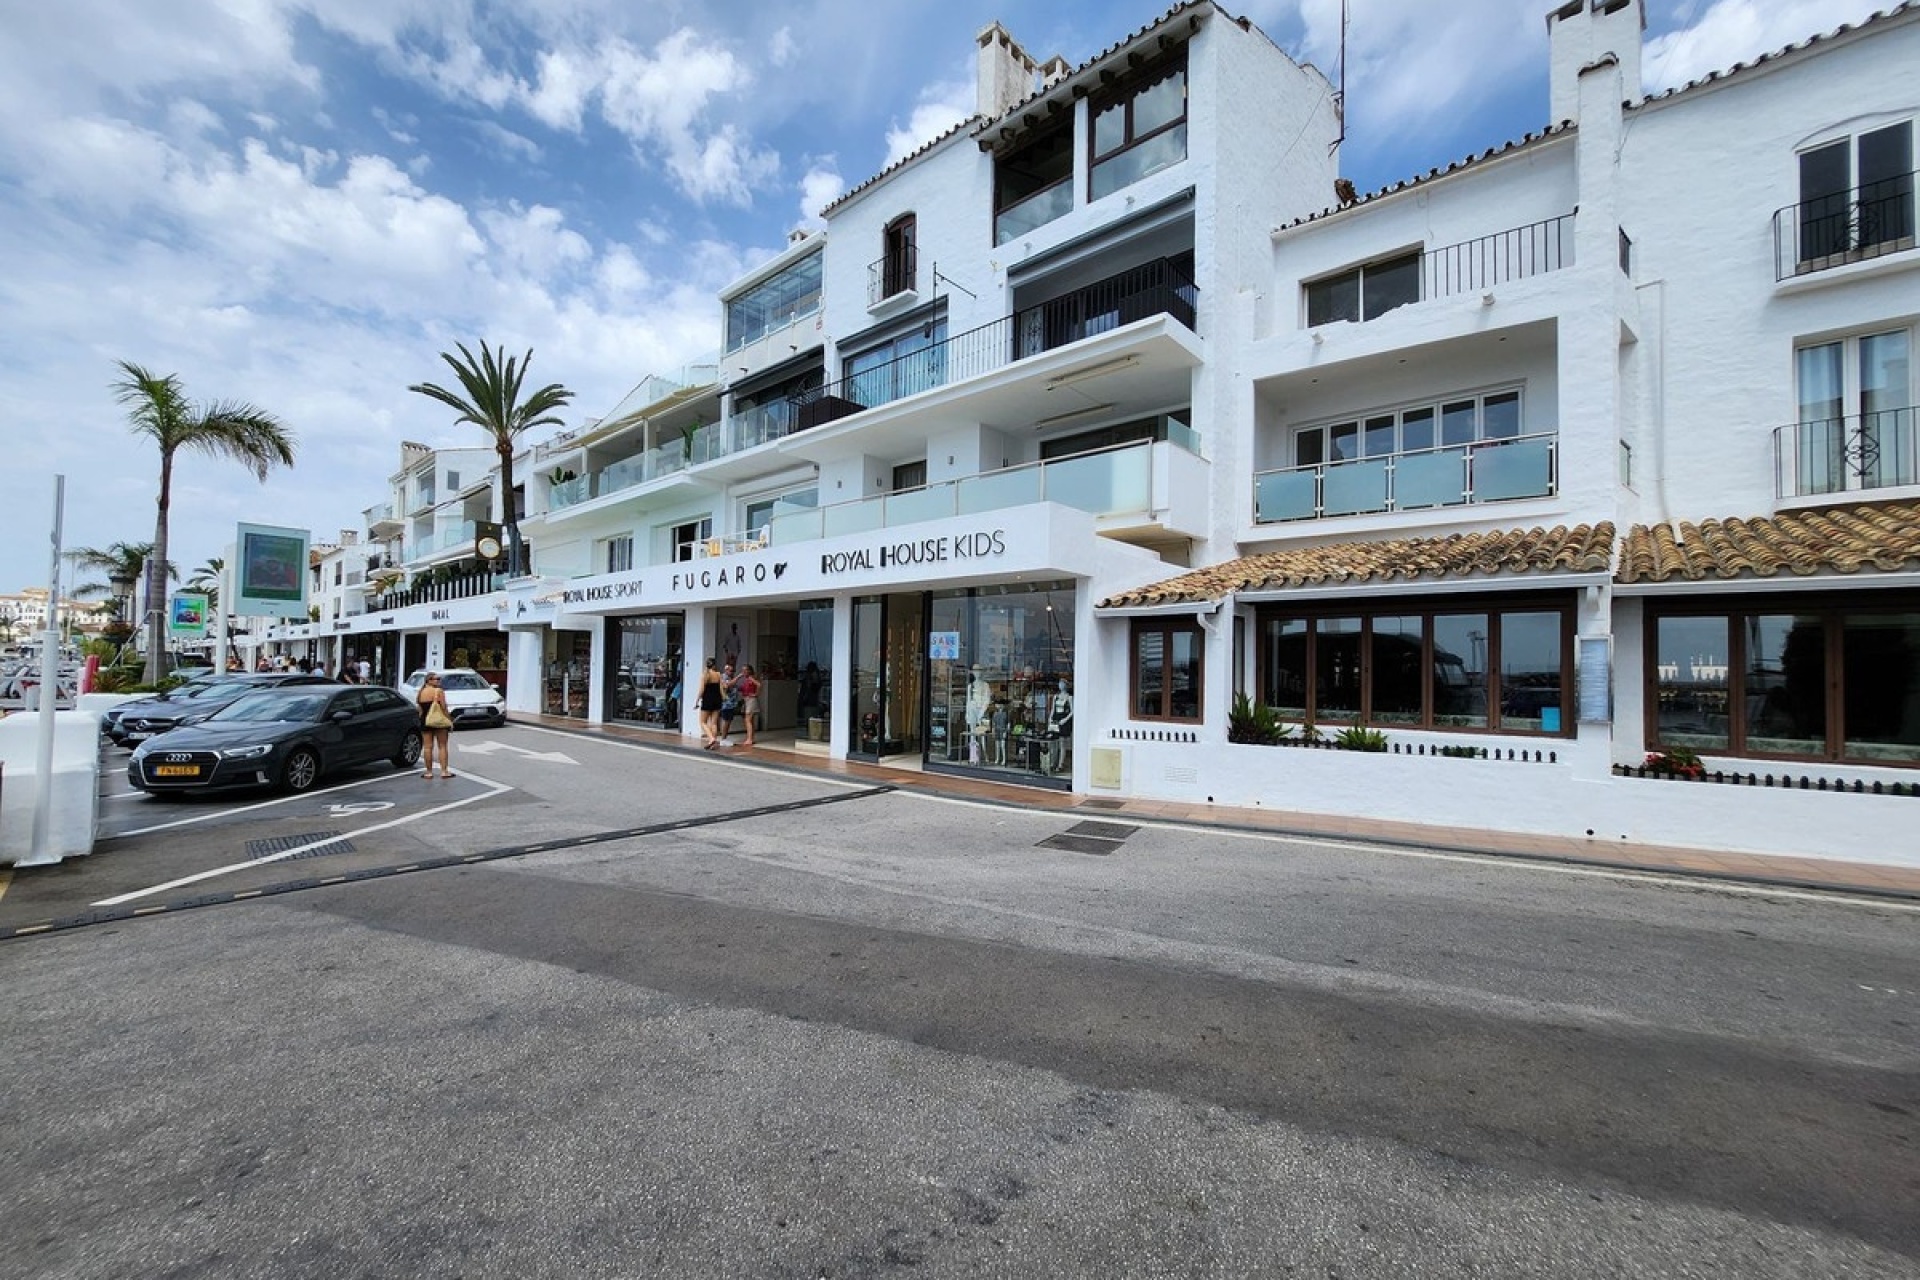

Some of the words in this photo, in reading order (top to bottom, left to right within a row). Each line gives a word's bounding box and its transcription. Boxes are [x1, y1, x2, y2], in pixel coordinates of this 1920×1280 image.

[821, 548, 874, 575] ROYAL
[879, 537, 948, 568] HOUSE
[954, 529, 1006, 559] KIDS
[671, 562, 767, 591] FUGARO
[563, 588, 585, 604] ROYAL
[587, 584, 613, 601] HOUSE
[614, 580, 643, 598] SPORT
